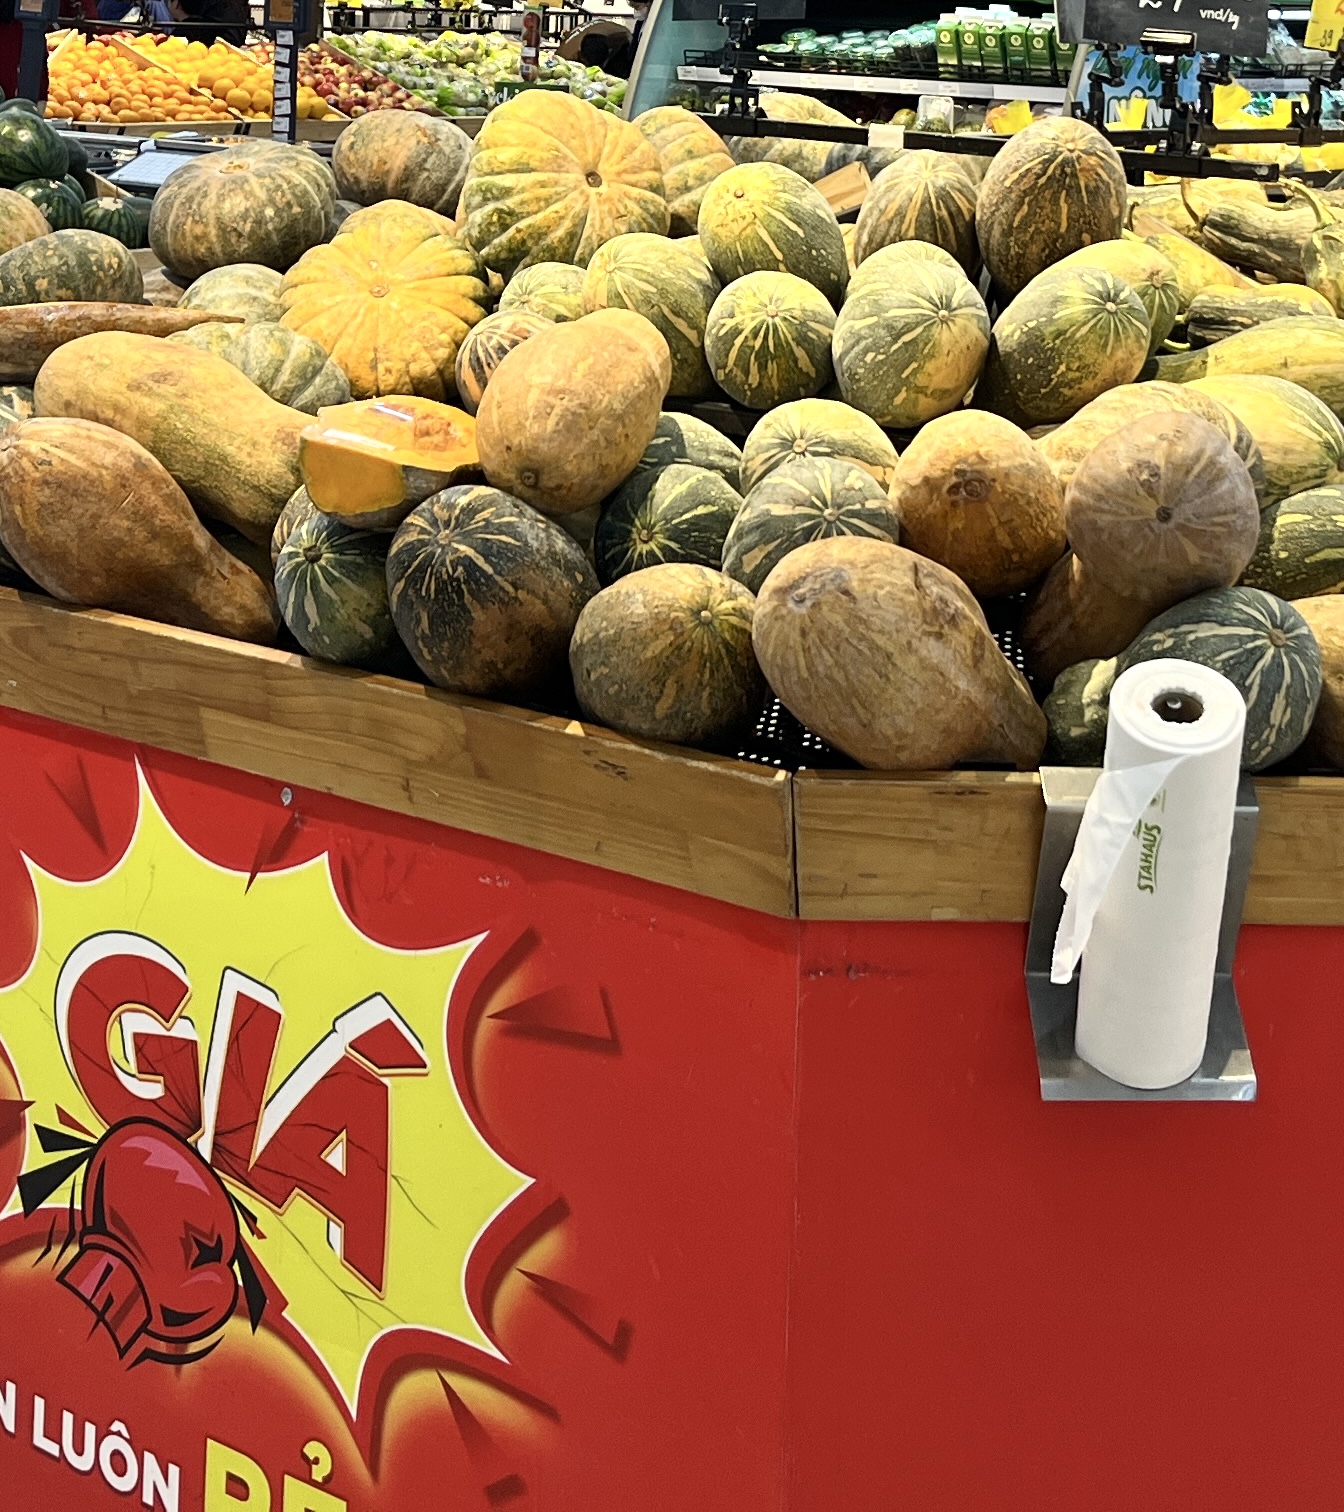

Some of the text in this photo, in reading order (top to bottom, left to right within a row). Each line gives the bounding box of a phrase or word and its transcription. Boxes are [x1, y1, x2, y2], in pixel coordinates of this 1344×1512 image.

[1137, 823, 1161, 894] STAHAUS
[54, 929, 431, 1300] GIÁ
[33, 1391, 181, 1512] LUÔN
